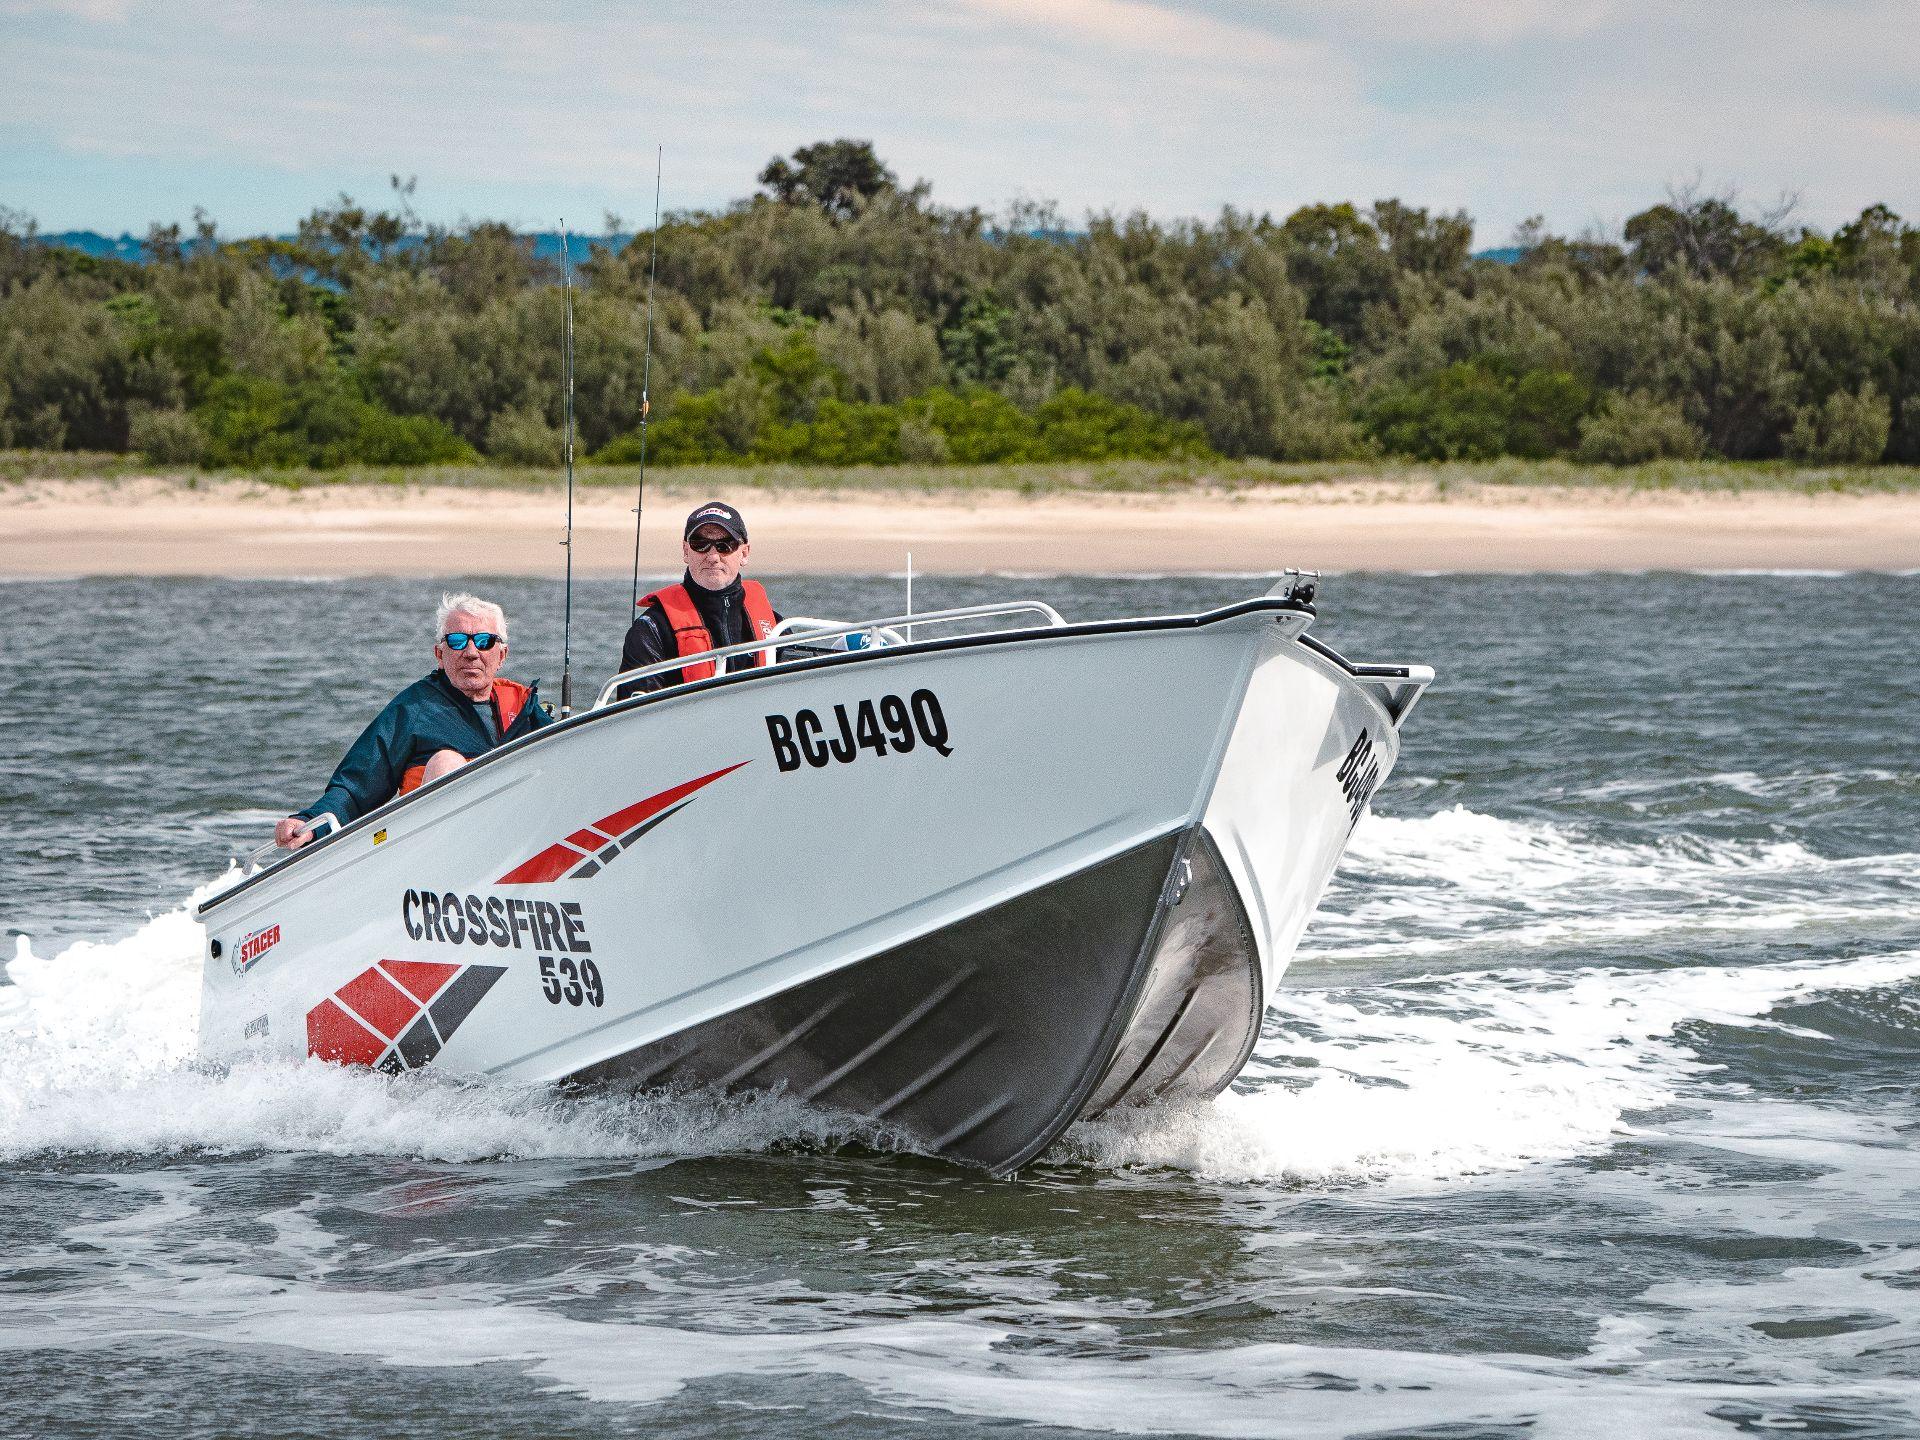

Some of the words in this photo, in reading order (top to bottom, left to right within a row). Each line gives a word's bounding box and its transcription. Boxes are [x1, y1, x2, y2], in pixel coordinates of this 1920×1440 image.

[765, 688, 954, 773] BCJ49Q
[241, 924, 281, 963] STACER
[402, 888, 592, 953] CROSSFIRE
[538, 956, 605, 1008] 539
